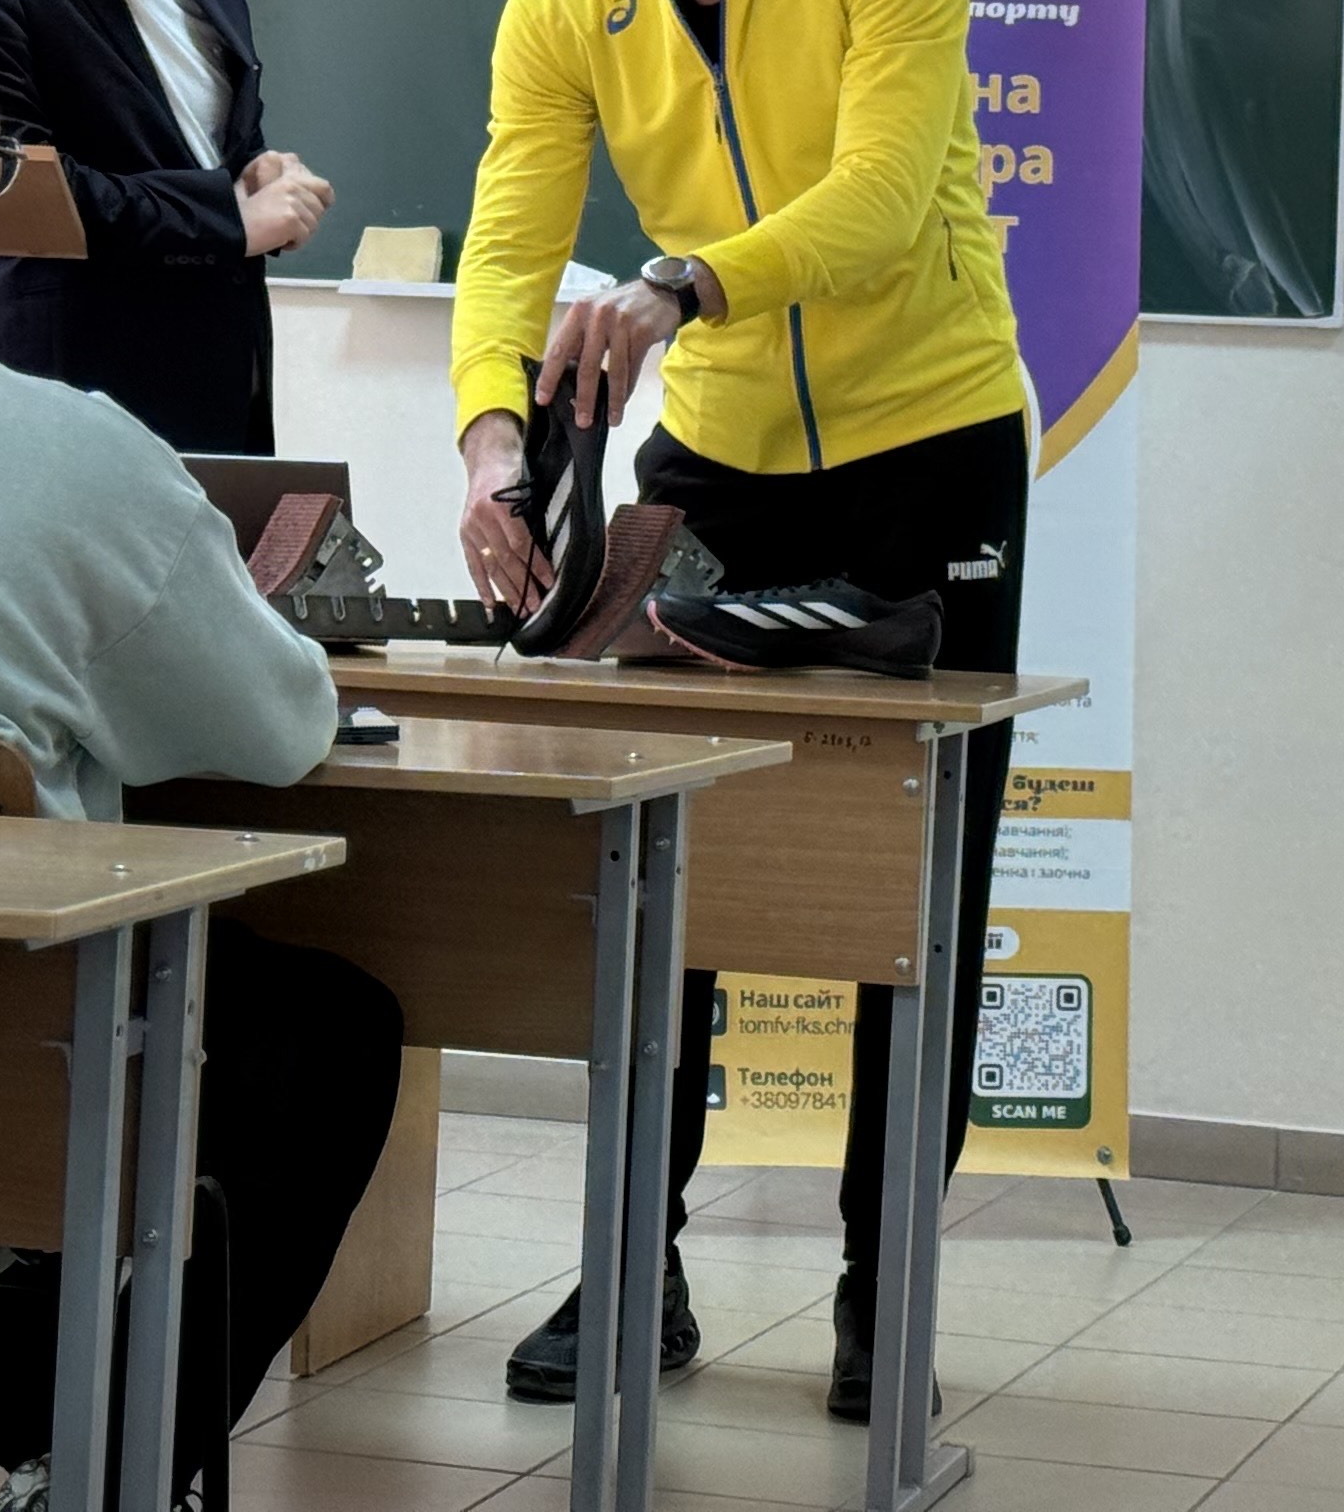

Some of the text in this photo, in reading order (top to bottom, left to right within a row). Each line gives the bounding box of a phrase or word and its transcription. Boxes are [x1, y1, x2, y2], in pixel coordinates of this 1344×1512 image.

[969, 1, 1080, 27] порту
[970, 73, 1041, 114] на
[981, 144, 1054, 198] ра
[947, 559, 999, 581] PUMA
[1012, 774, 1095, 795] будеш
[739, 989, 845, 1010] Наш сайт
[737, 1067, 834, 1091] Телефон
[992, 1104, 1067, 1120] SCAN ME
